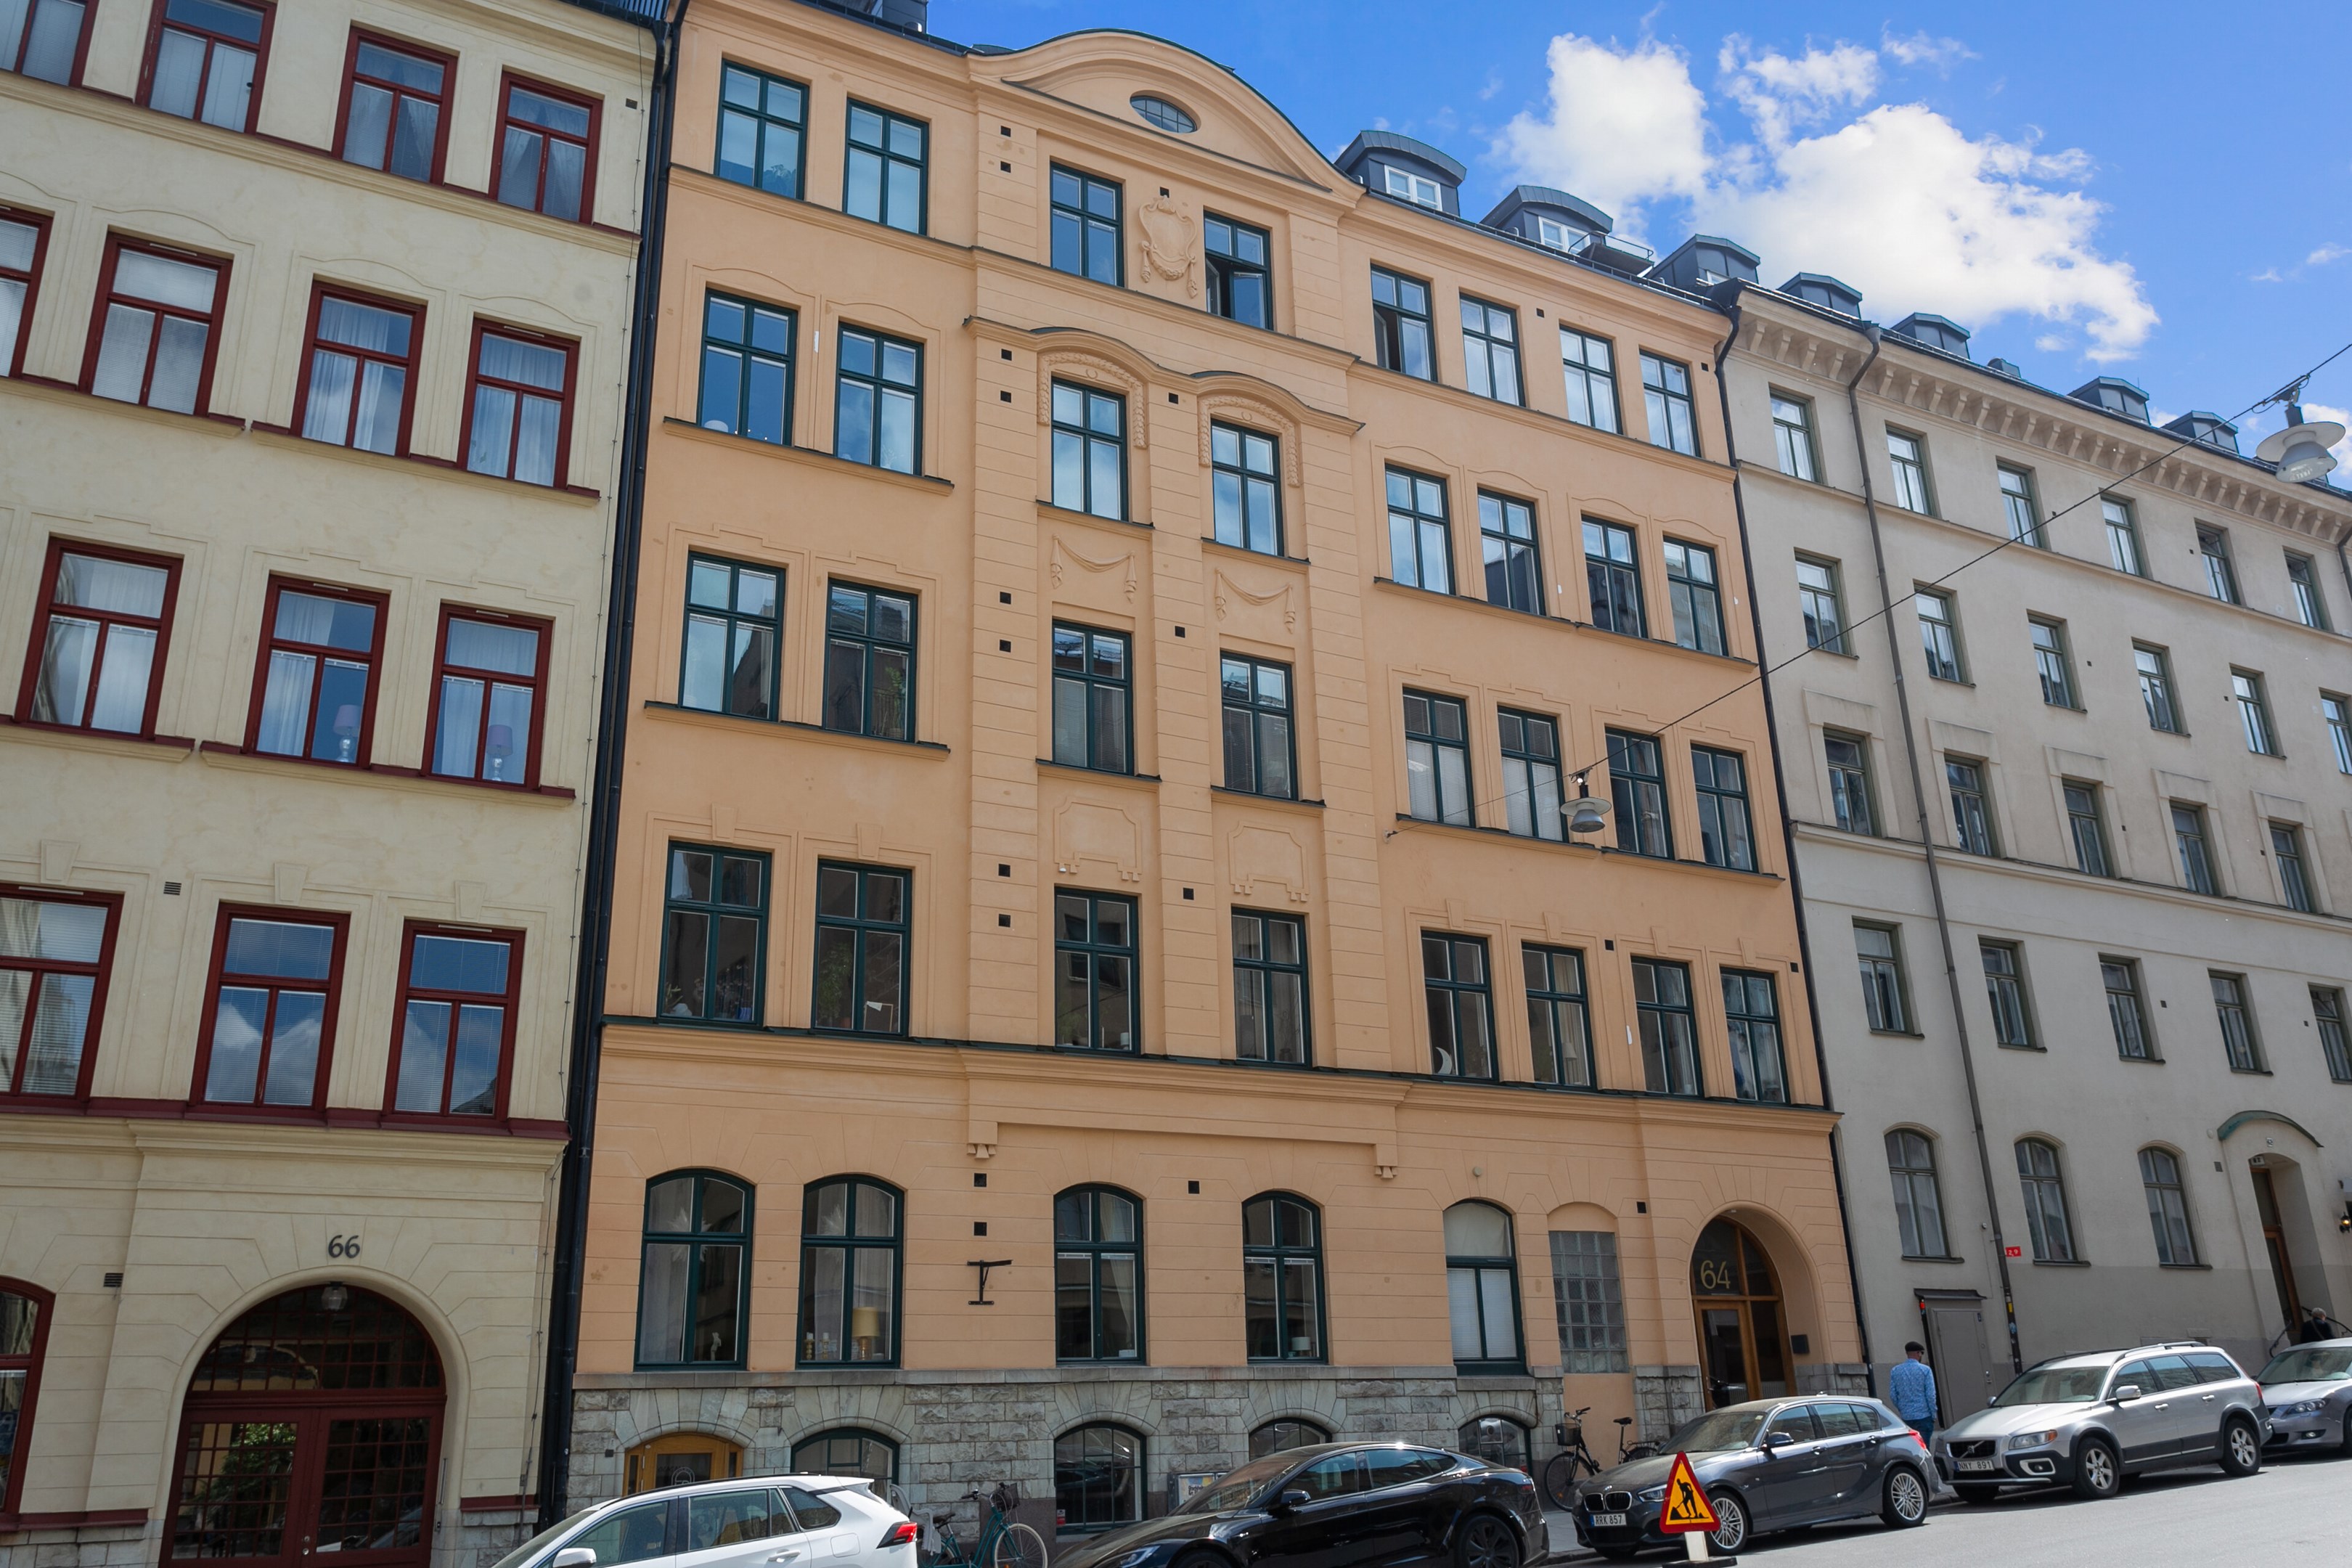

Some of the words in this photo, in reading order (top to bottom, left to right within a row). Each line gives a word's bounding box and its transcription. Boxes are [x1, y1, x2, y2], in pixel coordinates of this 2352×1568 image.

[328, 1234, 360, 1259] 66
[1700, 1259, 1731, 1289] 64
[1959, 1461, 1972, 1470] NNY
[1977, 1460, 1991, 1469] 891
[1595, 1515, 1608, 1525] RRK
[1609, 1514, 1622, 1524] 857
